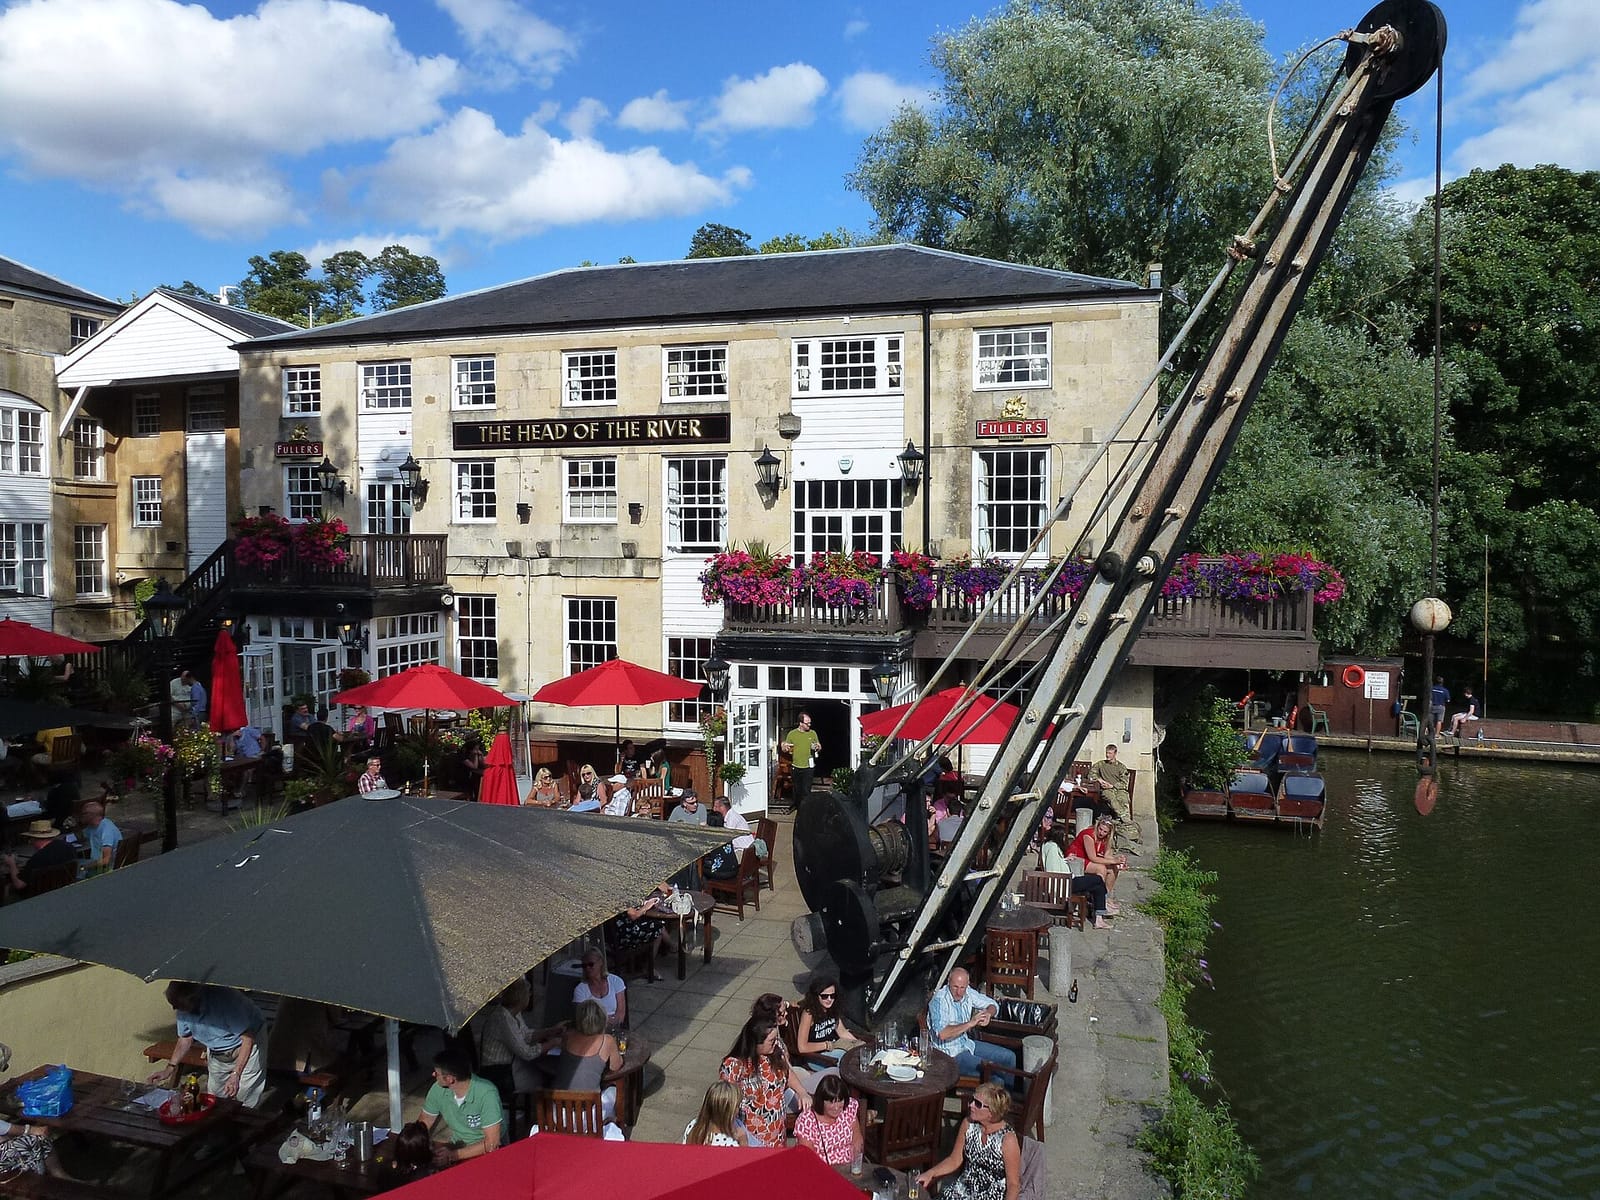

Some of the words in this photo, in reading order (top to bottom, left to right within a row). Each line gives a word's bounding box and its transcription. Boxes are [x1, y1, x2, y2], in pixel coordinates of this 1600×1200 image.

[479, 425, 511, 442] THE
[518, 423, 568, 442] HEAD
[573, 422, 599, 440] OF
[605, 421, 640, 439] THE
[647, 419, 702, 438] RIVER
[980, 421, 1042, 434] FULLER'S
